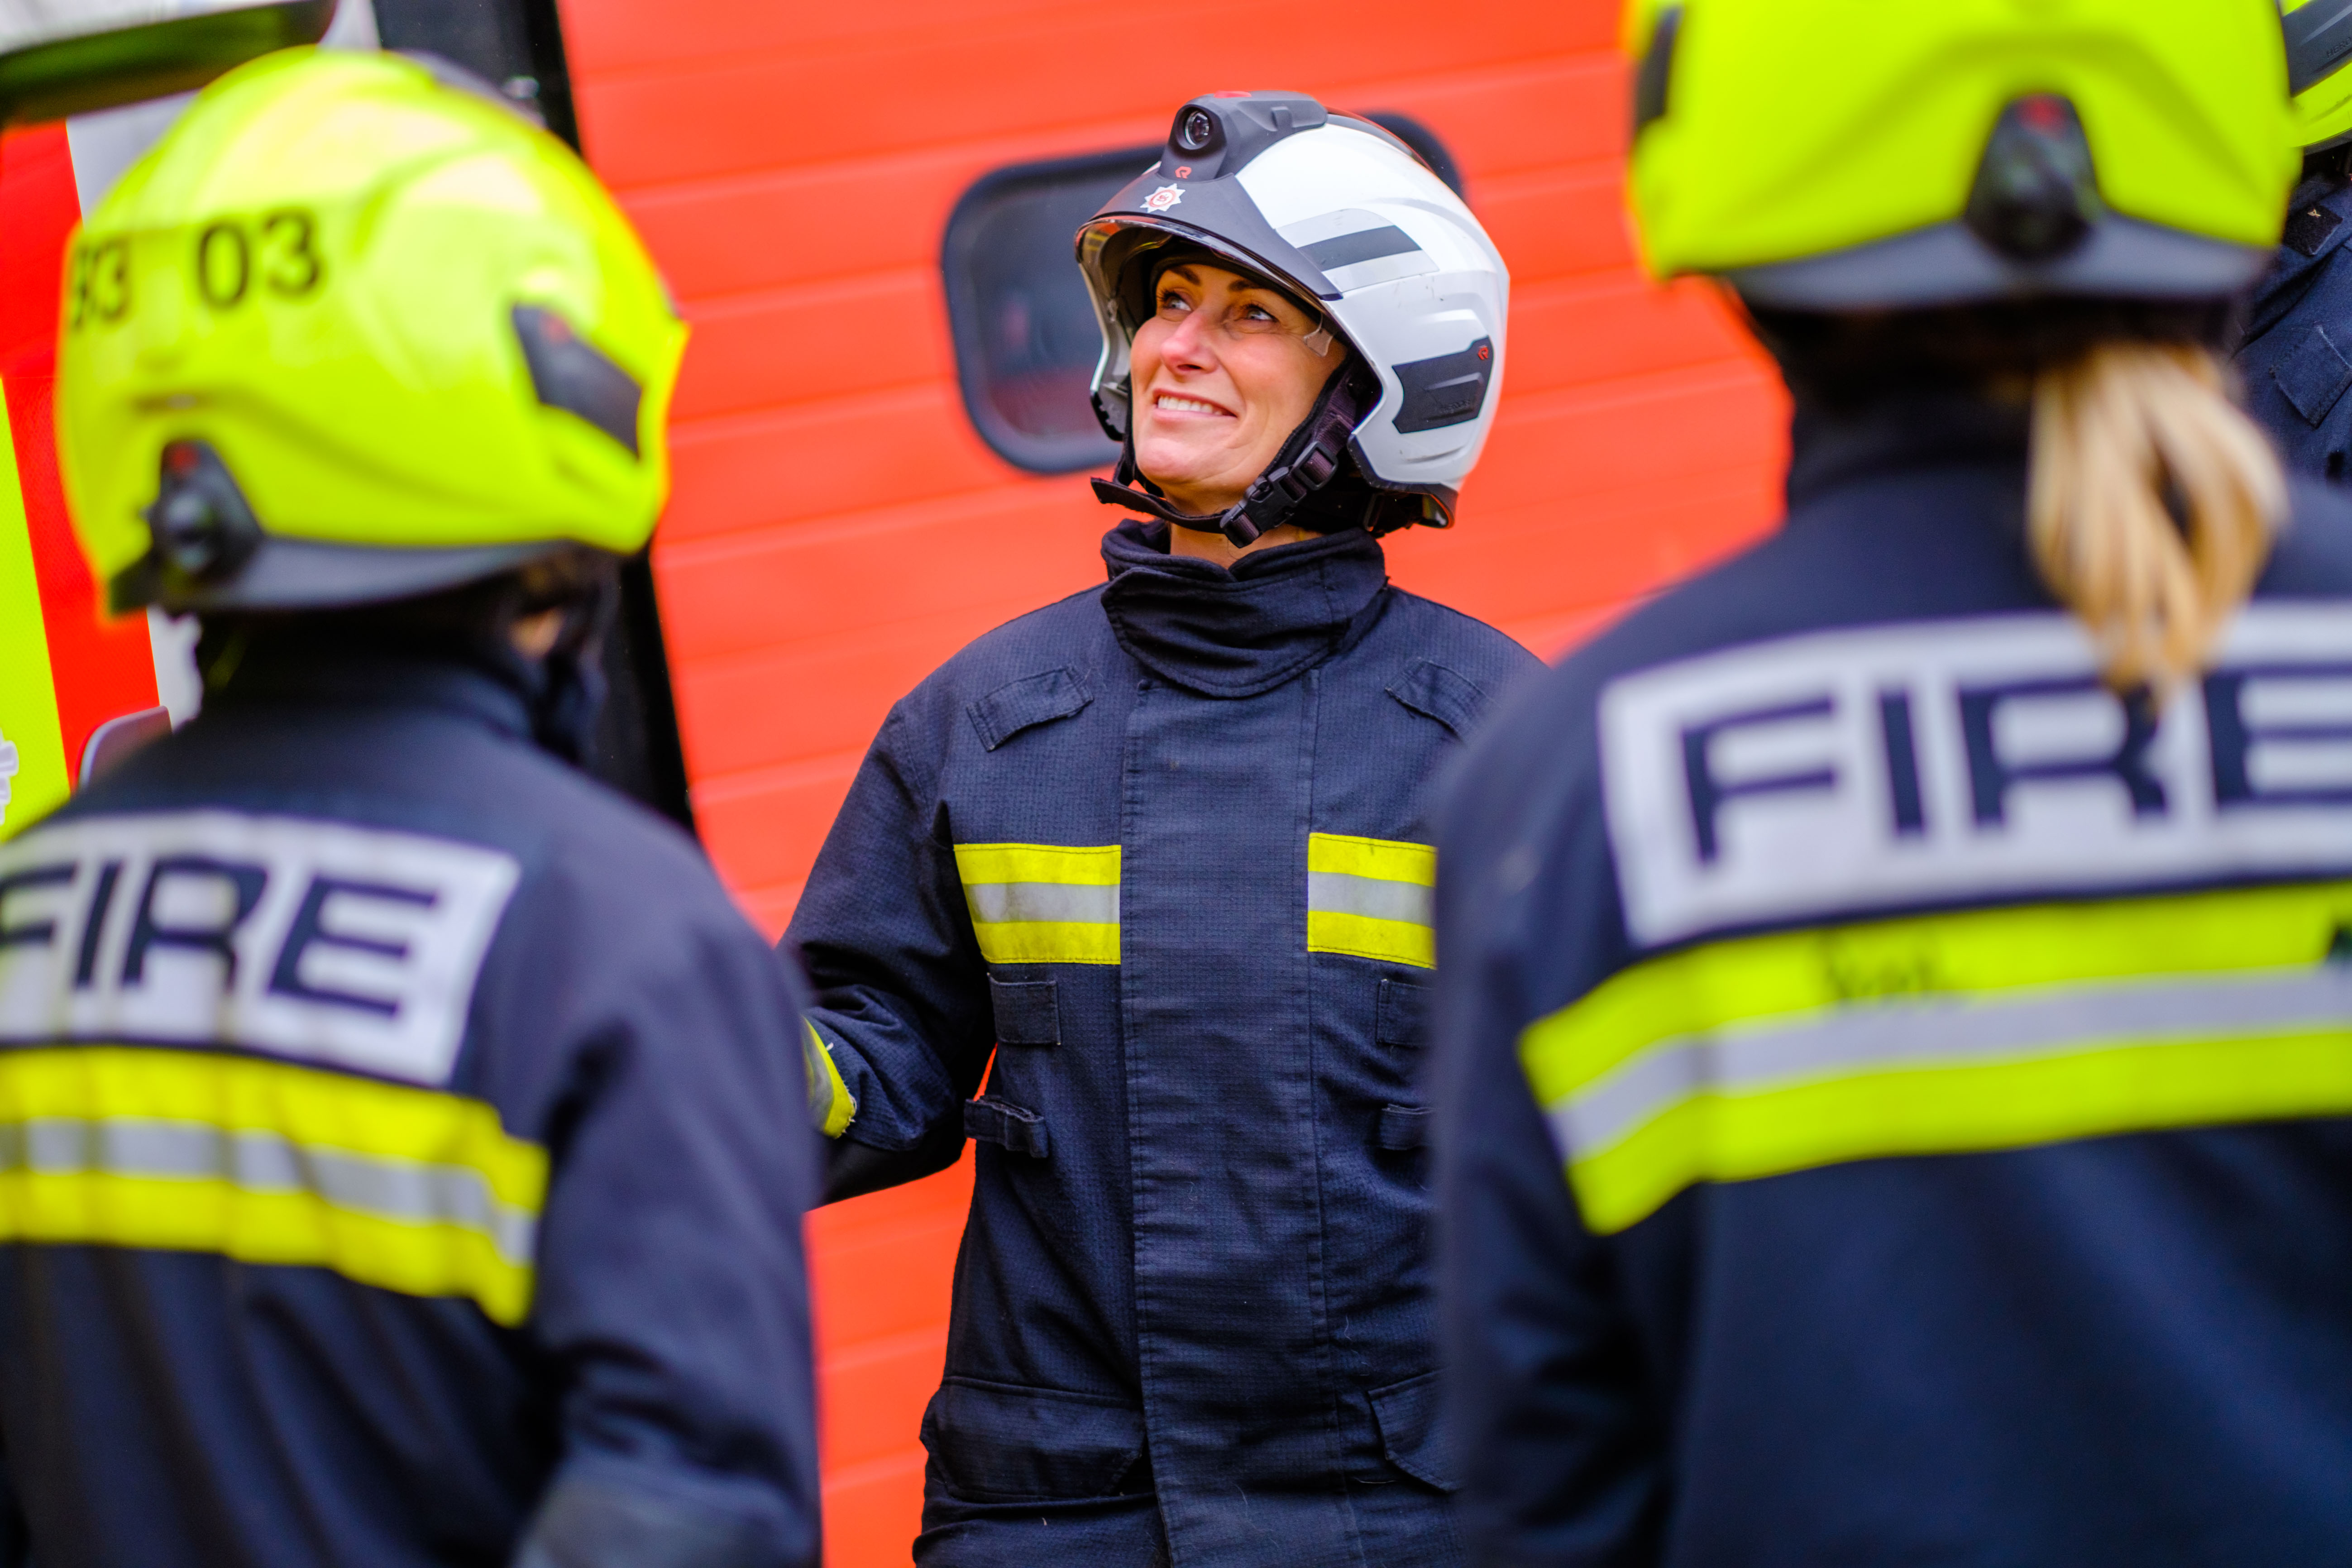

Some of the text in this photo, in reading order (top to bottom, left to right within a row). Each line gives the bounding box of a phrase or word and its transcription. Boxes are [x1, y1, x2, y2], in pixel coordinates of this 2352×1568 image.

[198, 209, 326, 312] 03
[1680, 663, 2352, 864] FIRE
[0, 859, 440, 1017] FIRE
